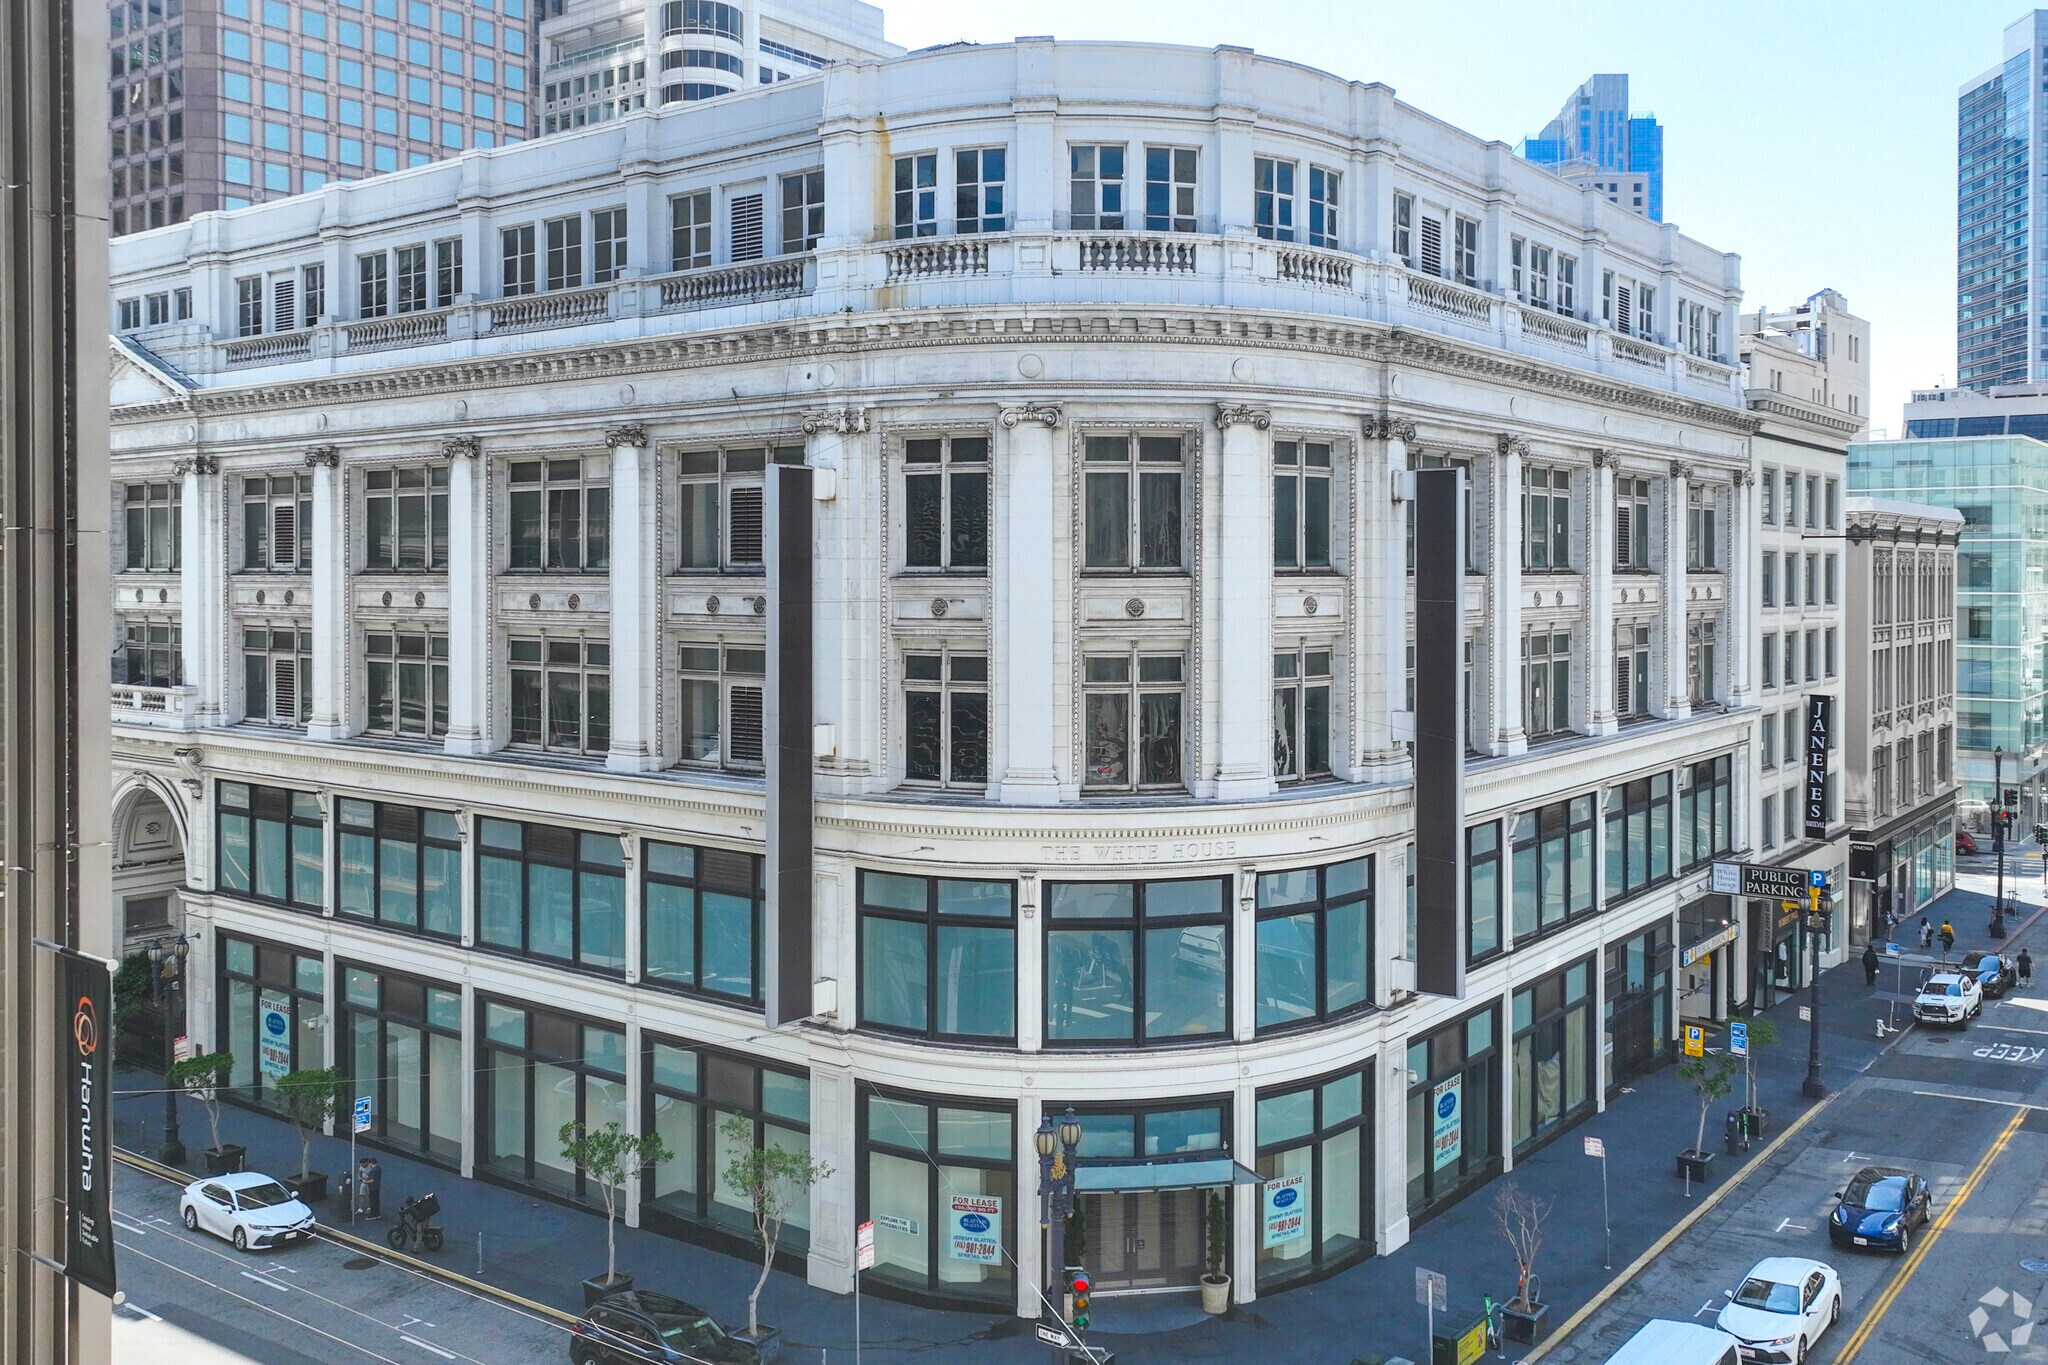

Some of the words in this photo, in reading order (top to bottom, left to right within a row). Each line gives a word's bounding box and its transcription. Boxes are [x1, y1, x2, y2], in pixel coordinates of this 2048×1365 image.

[1809, 701, 1827, 818] JANENES
[1805, 820, 1826, 829] BRIDAL
[1041, 845, 1081, 861] THE
[1093, 845, 1160, 861] WHITE
[1172, 841, 1237, 860] HOUSE
[1852, 844, 1874, 852] RIMOWA
[1716, 868, 1738, 876] White
[1717, 874, 1738, 882] House
[1751, 869, 1799, 885] PUBLIC
[1813, 872, 1823, 885] P
[1746, 881, 1804, 898] PARKING
[261, 1000, 272, 1010] FOR
[273, 1003, 290, 1014] LEASE
[1691, 1028, 1699, 1039] P
[1973, 1043, 2046, 1063] KEEP
[1434, 1085, 1444, 1097] FOR
[1445, 1076, 1461, 1092] LEASE
[81, 1061, 94, 1191] Hanwha
[1267, 1182, 1281, 1191] FOR
[1282, 1176, 1303, 1188] LEASE
[952, 1196, 969, 1205] FOR
[971, 1199, 998, 1208] LEASE
[880, 1215, 899, 1224] EXPLORE
[880, 1221, 908, 1232] POSSIBILITIES
[966, 1242, 996, 1256] 981-2844
[1040, 1330, 1049, 1338] ONE
